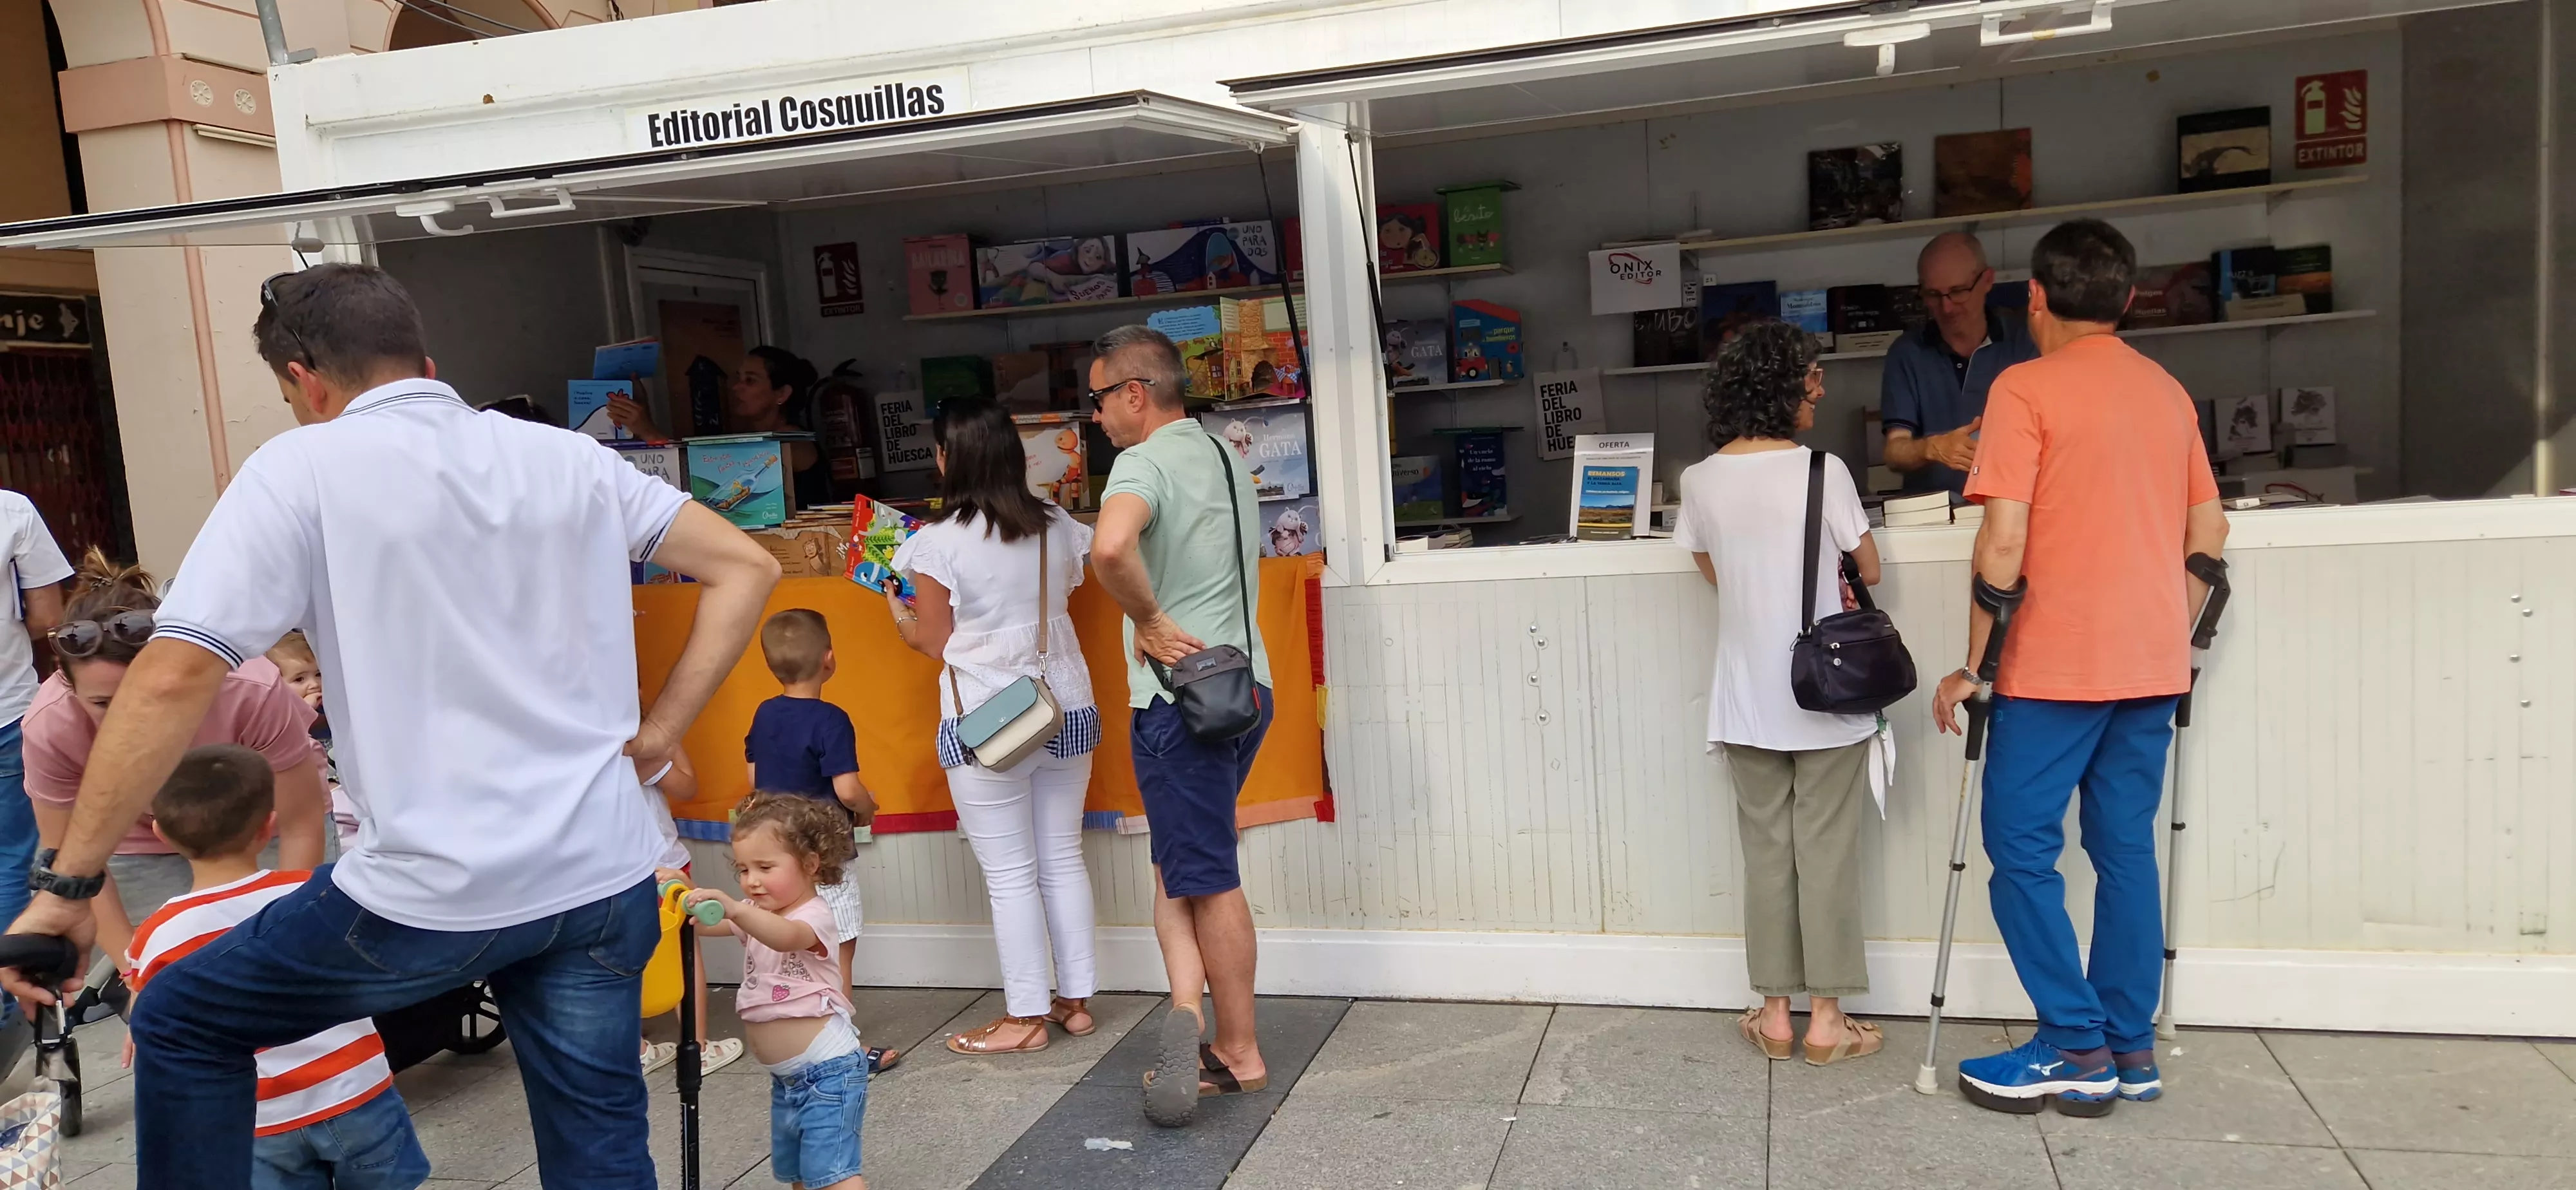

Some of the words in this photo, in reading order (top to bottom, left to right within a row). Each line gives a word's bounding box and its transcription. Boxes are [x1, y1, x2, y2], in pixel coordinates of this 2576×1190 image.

[647, 99, 773, 147] Editorial
[779, 82, 945, 131] Cosquillas
[2298, 143, 2364, 163] EXTINTOR
[1243, 225, 1262, 234] UNO
[1243, 234, 1267, 246] PARA
[1247, 247, 1268, 256] DOS
[1610, 260, 1653, 274] ONIX
[1620, 270, 1662, 280] EDITOR
[1411, 345, 1443, 358] GATA
[1540, 381, 1578, 398] FERIA
[880, 400, 913, 415] FERIA
[1542, 397, 1566, 411] DEL
[884, 414, 904, 427] DEL
[1544, 408, 1582, 425] LIBRO
[884, 424, 916, 439] LIBRO
[1546, 424, 1563, 439] DE
[886, 439, 901, 451] DE
[1260, 441, 1302, 458] GATA
[1548, 436, 1576, 452] HUE
[640, 453, 665, 464] UNO
[888, 447, 933, 464] HUESCA
